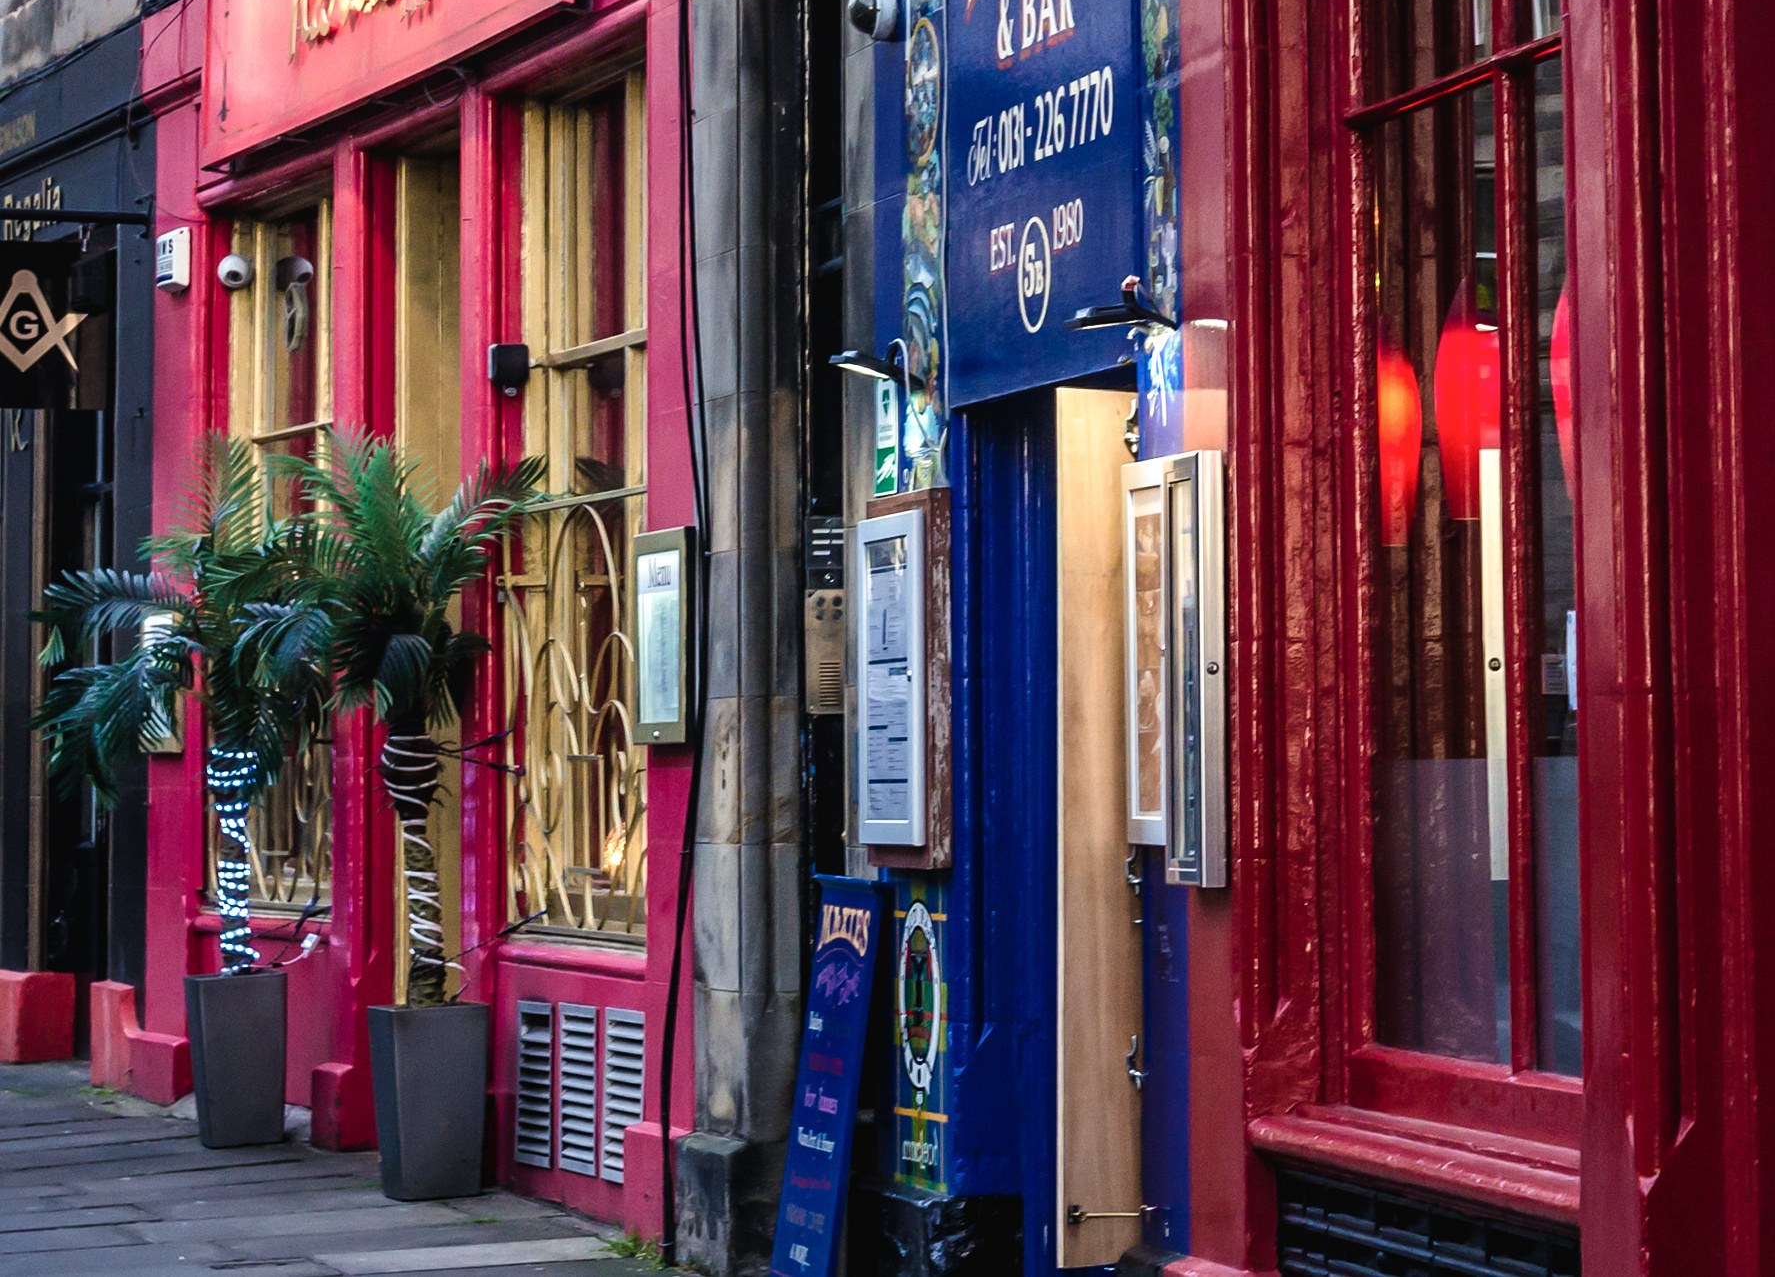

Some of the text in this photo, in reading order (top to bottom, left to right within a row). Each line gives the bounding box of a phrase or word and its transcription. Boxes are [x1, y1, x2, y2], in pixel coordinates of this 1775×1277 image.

[1069, 65, 1114, 148] 7770
[990, 198, 1084, 273] EST. 1980
[9, 310, 40, 340] G
